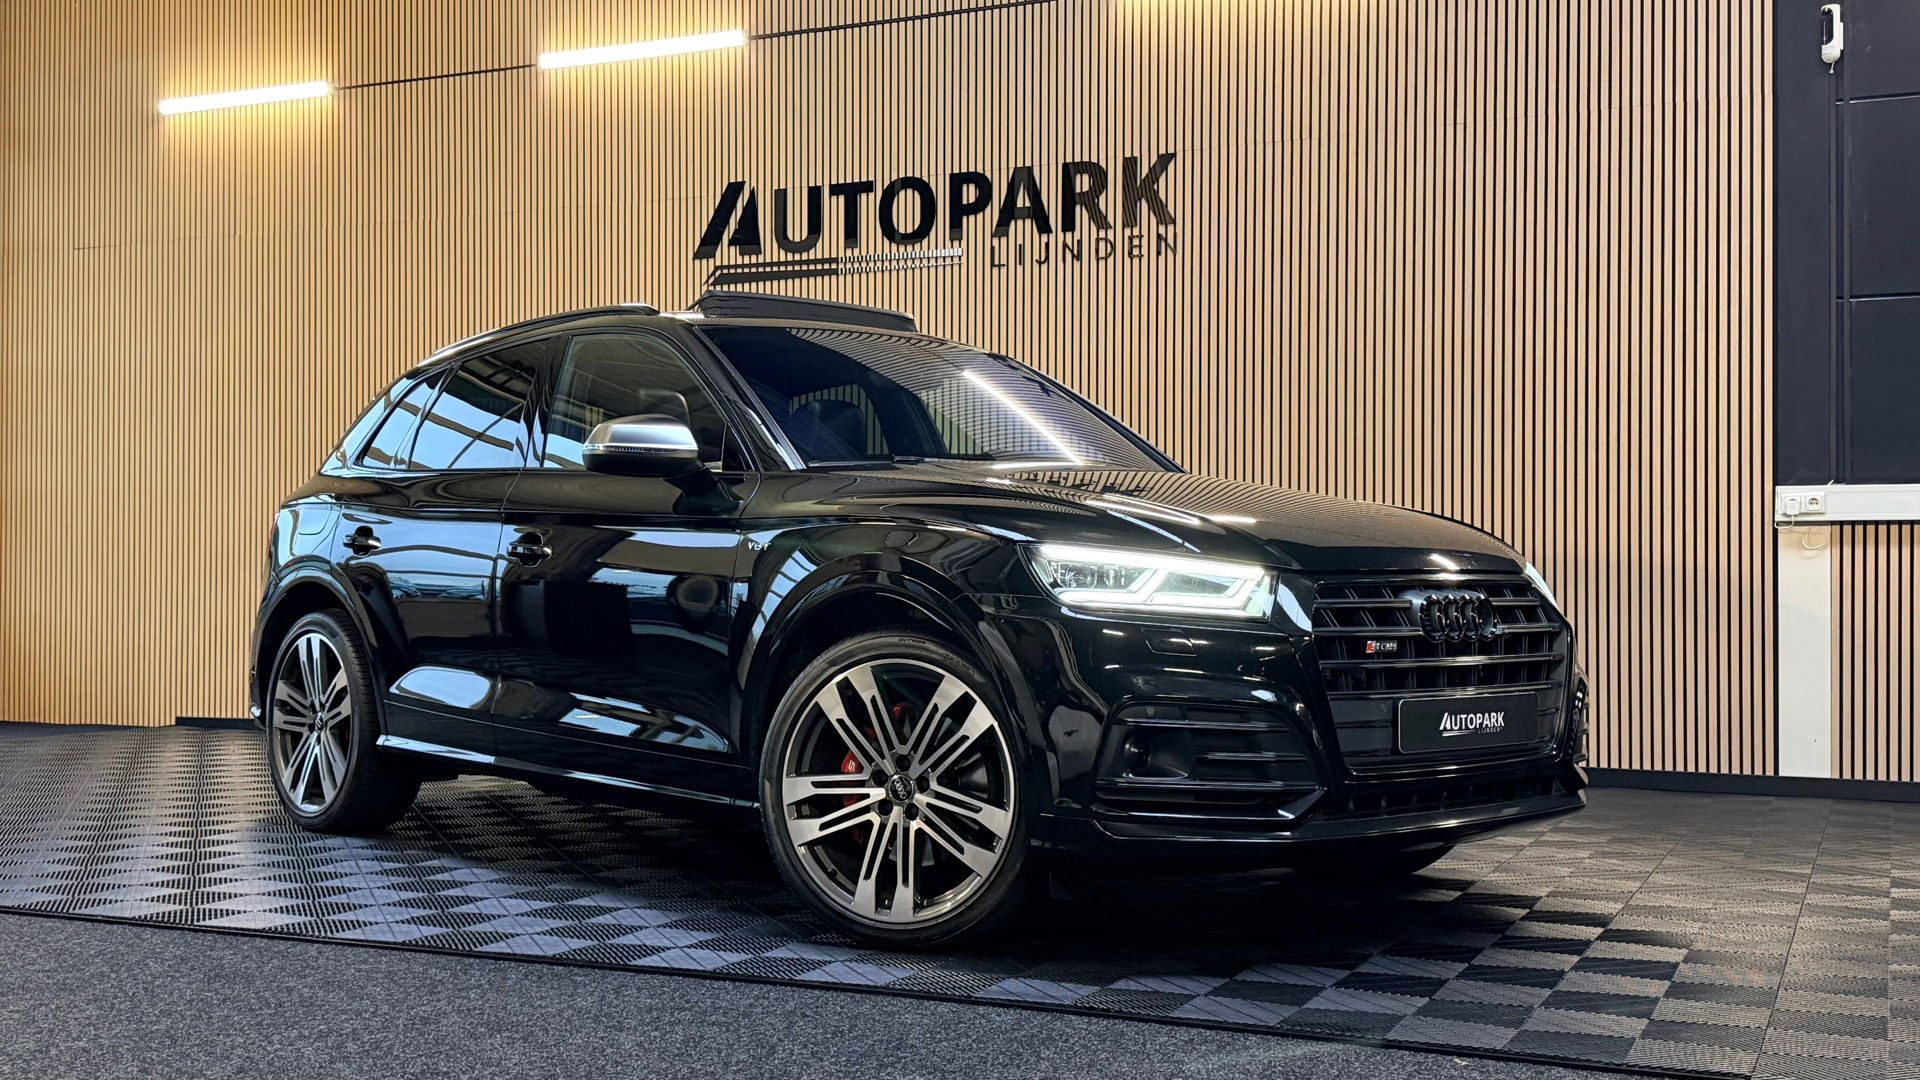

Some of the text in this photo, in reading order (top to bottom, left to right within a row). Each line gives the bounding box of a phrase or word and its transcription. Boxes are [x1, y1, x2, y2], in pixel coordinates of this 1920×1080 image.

[693, 153, 1177, 260] AUTOPARK
[990, 232, 1178, 268] LIJNDEN
[1439, 711, 1505, 731] AUTOPARK
